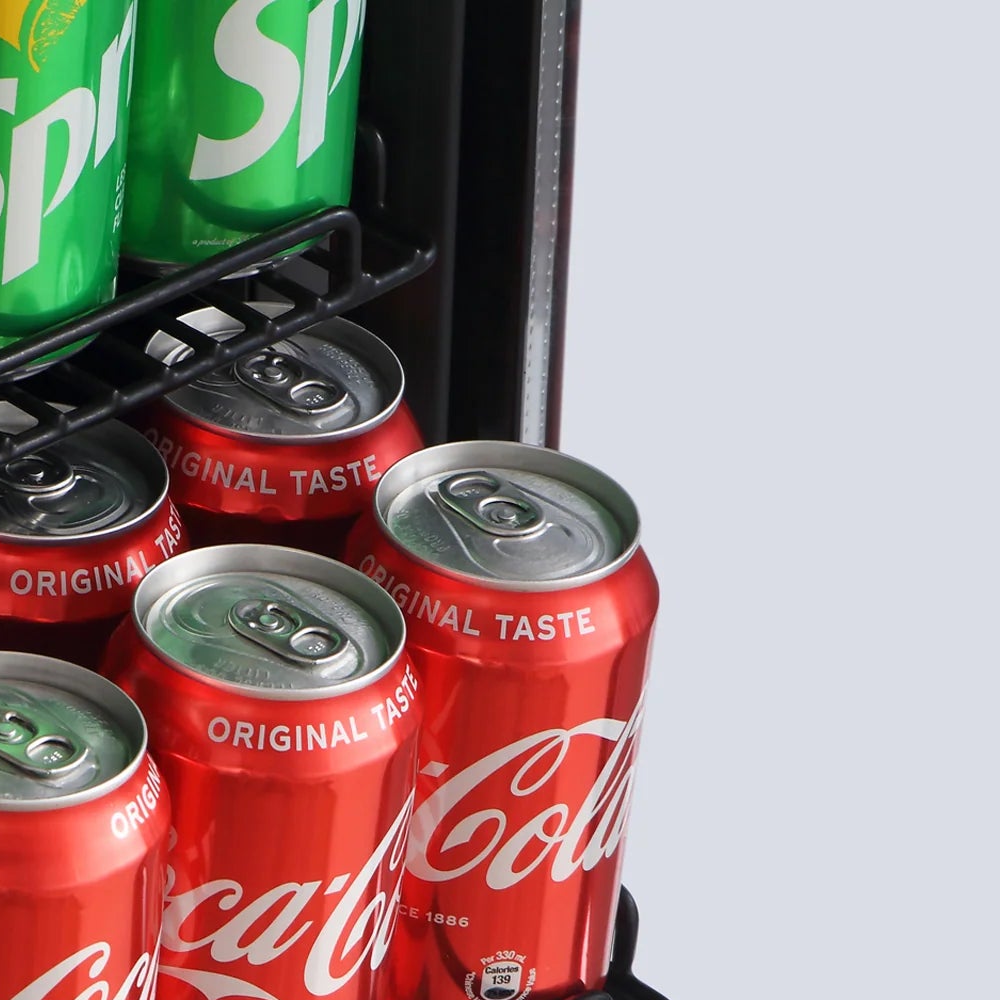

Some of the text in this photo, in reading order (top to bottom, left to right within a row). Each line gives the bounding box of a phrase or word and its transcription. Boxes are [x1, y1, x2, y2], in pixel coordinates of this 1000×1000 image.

[290, 454, 382, 496] TASTE
[10, 497, 183, 597] ORIGINAL TAST
[359, 554, 596, 641] ORIGINAL TASTE
[207, 664, 419, 752] ORIGINAL TASTE
[111, 753, 161, 840] ORIGIN
[425, 911, 470, 928] 1886
[480, 956, 495, 965] Per
[496, 950, 516, 960] 330
[485, 966, 519, 974] Calories
[492, 974, 511, 985] 139
